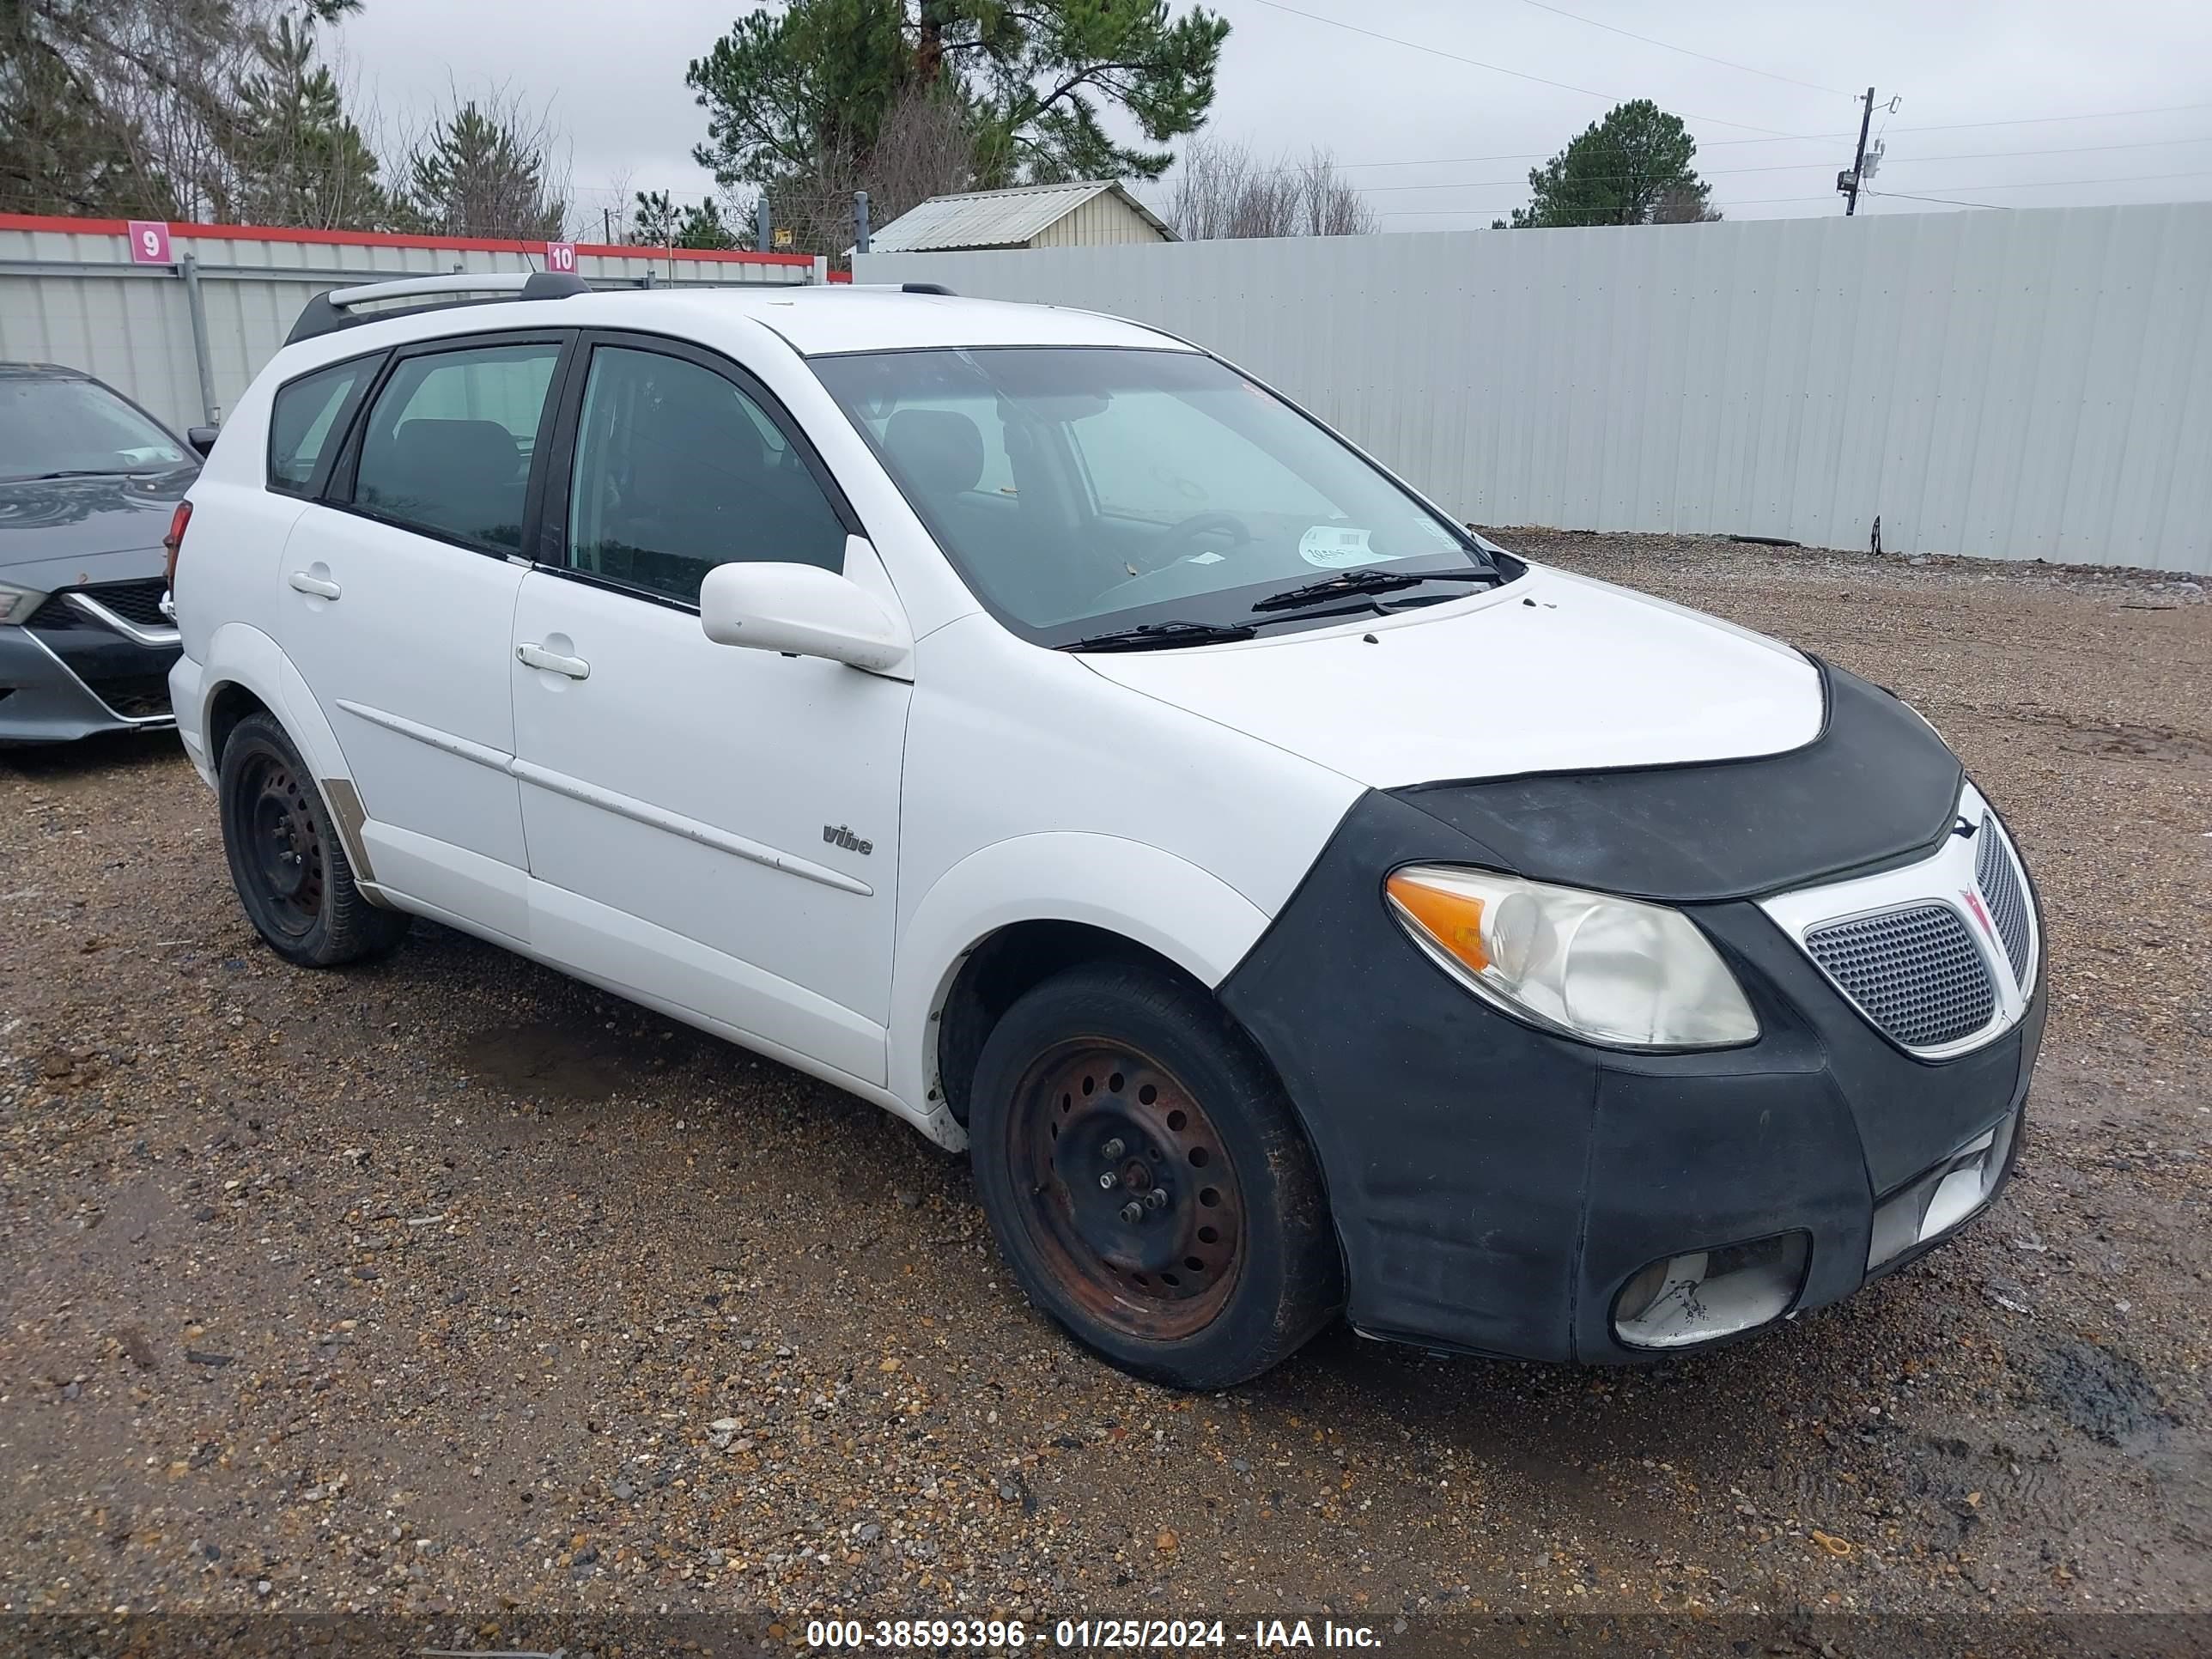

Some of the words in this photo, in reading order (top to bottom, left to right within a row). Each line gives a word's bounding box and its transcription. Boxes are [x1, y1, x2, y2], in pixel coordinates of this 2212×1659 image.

[143, 230, 160, 257] 9
[553, 247, 573, 270] 10
[823, 823, 873, 855] vibe
